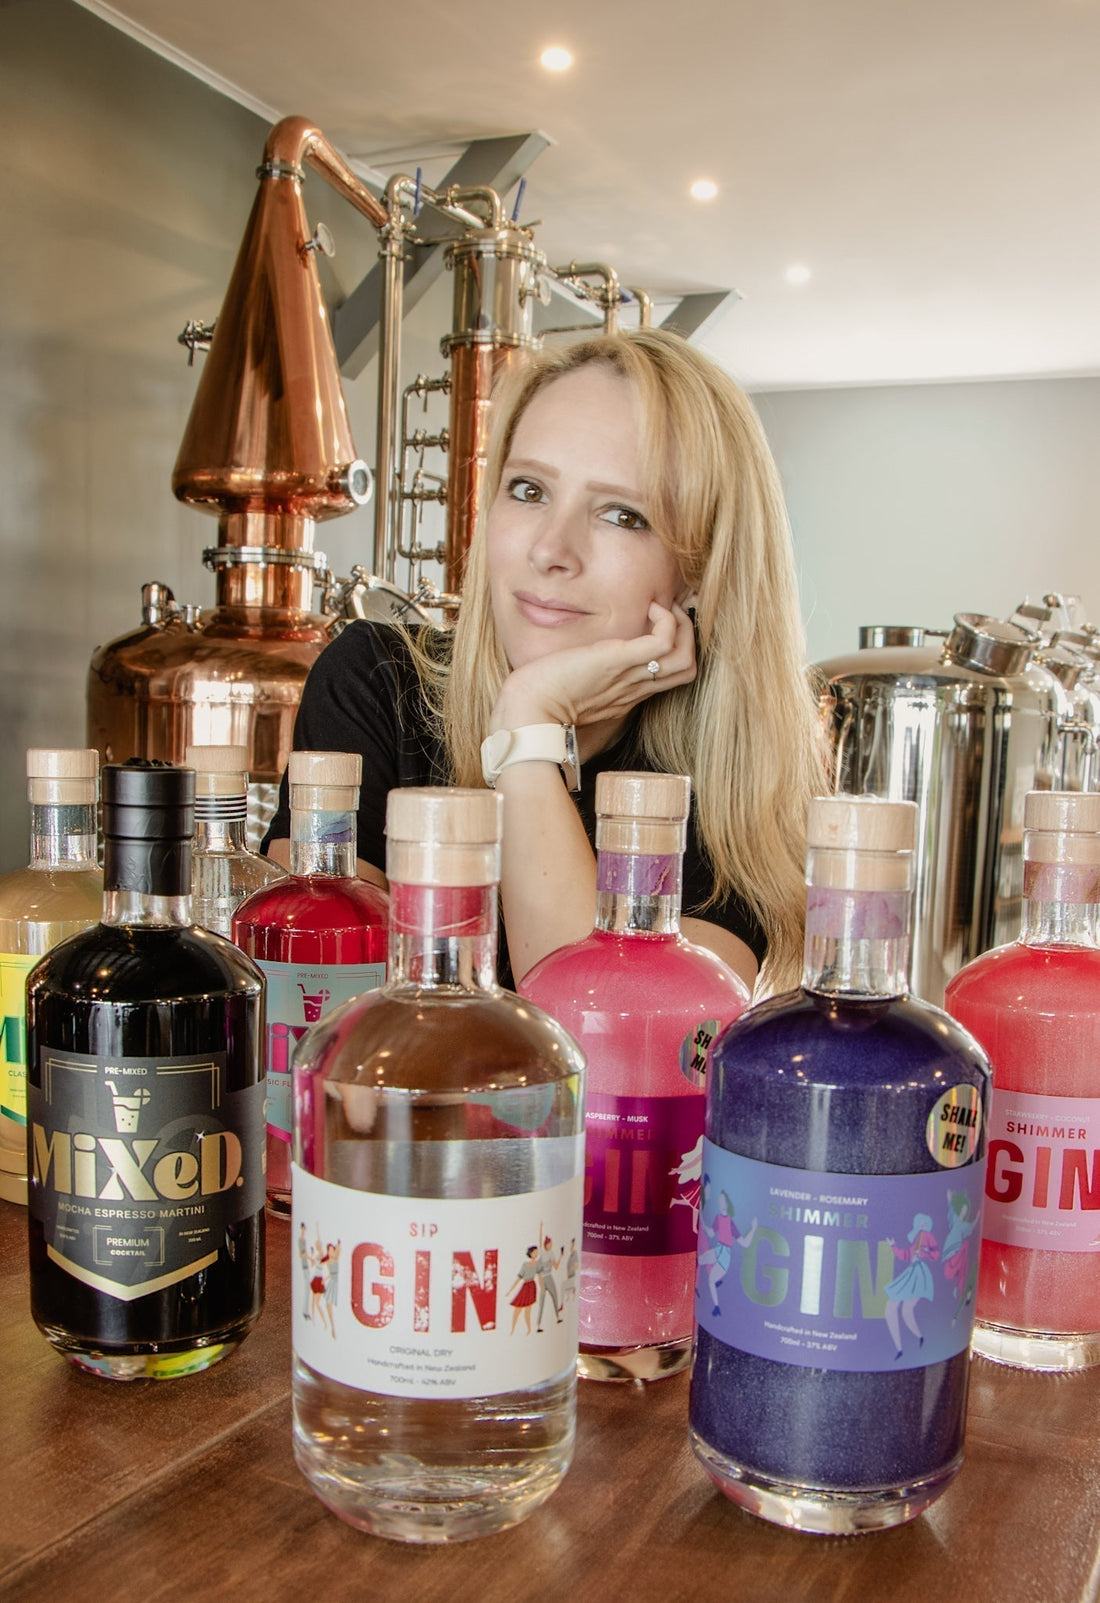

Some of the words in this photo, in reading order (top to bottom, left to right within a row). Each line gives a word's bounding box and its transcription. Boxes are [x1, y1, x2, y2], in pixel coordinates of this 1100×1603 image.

[694, 1030, 712, 1050] SH
[8, 1070, 27, 1078] CLAS
[104, 1066, 148, 1076] PRE-MIXED
[585, 1111, 621, 1121] ASPBERRY
[627, 1115, 648, 1123] MUSK
[1006, 1121, 1087, 1140] SHIMMER
[942, 1132, 966, 1153] ME!
[985, 1139, 1100, 1211] GIN
[769, 1187, 812, 1201] LAVENDER
[819, 1194, 868, 1206] ROSEMARY
[58, 1202, 91, 1216] MOCHA
[94, 1208, 156, 1219] ESPRESSO
[159, 1205, 205, 1218] MARTINI
[768, 1203, 868, 1228] SHIMMER
[409, 1222, 438, 1238] SIP
[583, 1221, 606, 1230] dcrafted
[106, 1237, 150, 1247] PREMIUM
[110, 1249, 146, 1257] COCKTAIL
[741, 1225, 895, 1319] GIN
[351, 1241, 499, 1333] GIN
[764, 1320, 803, 1335] Handcrafted
[812, 1329, 829, 1338] New
[829, 1331, 857, 1341] Zealand
[389, 1345, 431, 1357] ORIGINAL
[434, 1348, 453, 1357] DRY
[822, 1343, 838, 1351] ABV
[444, 1364, 476, 1372] Zealand
